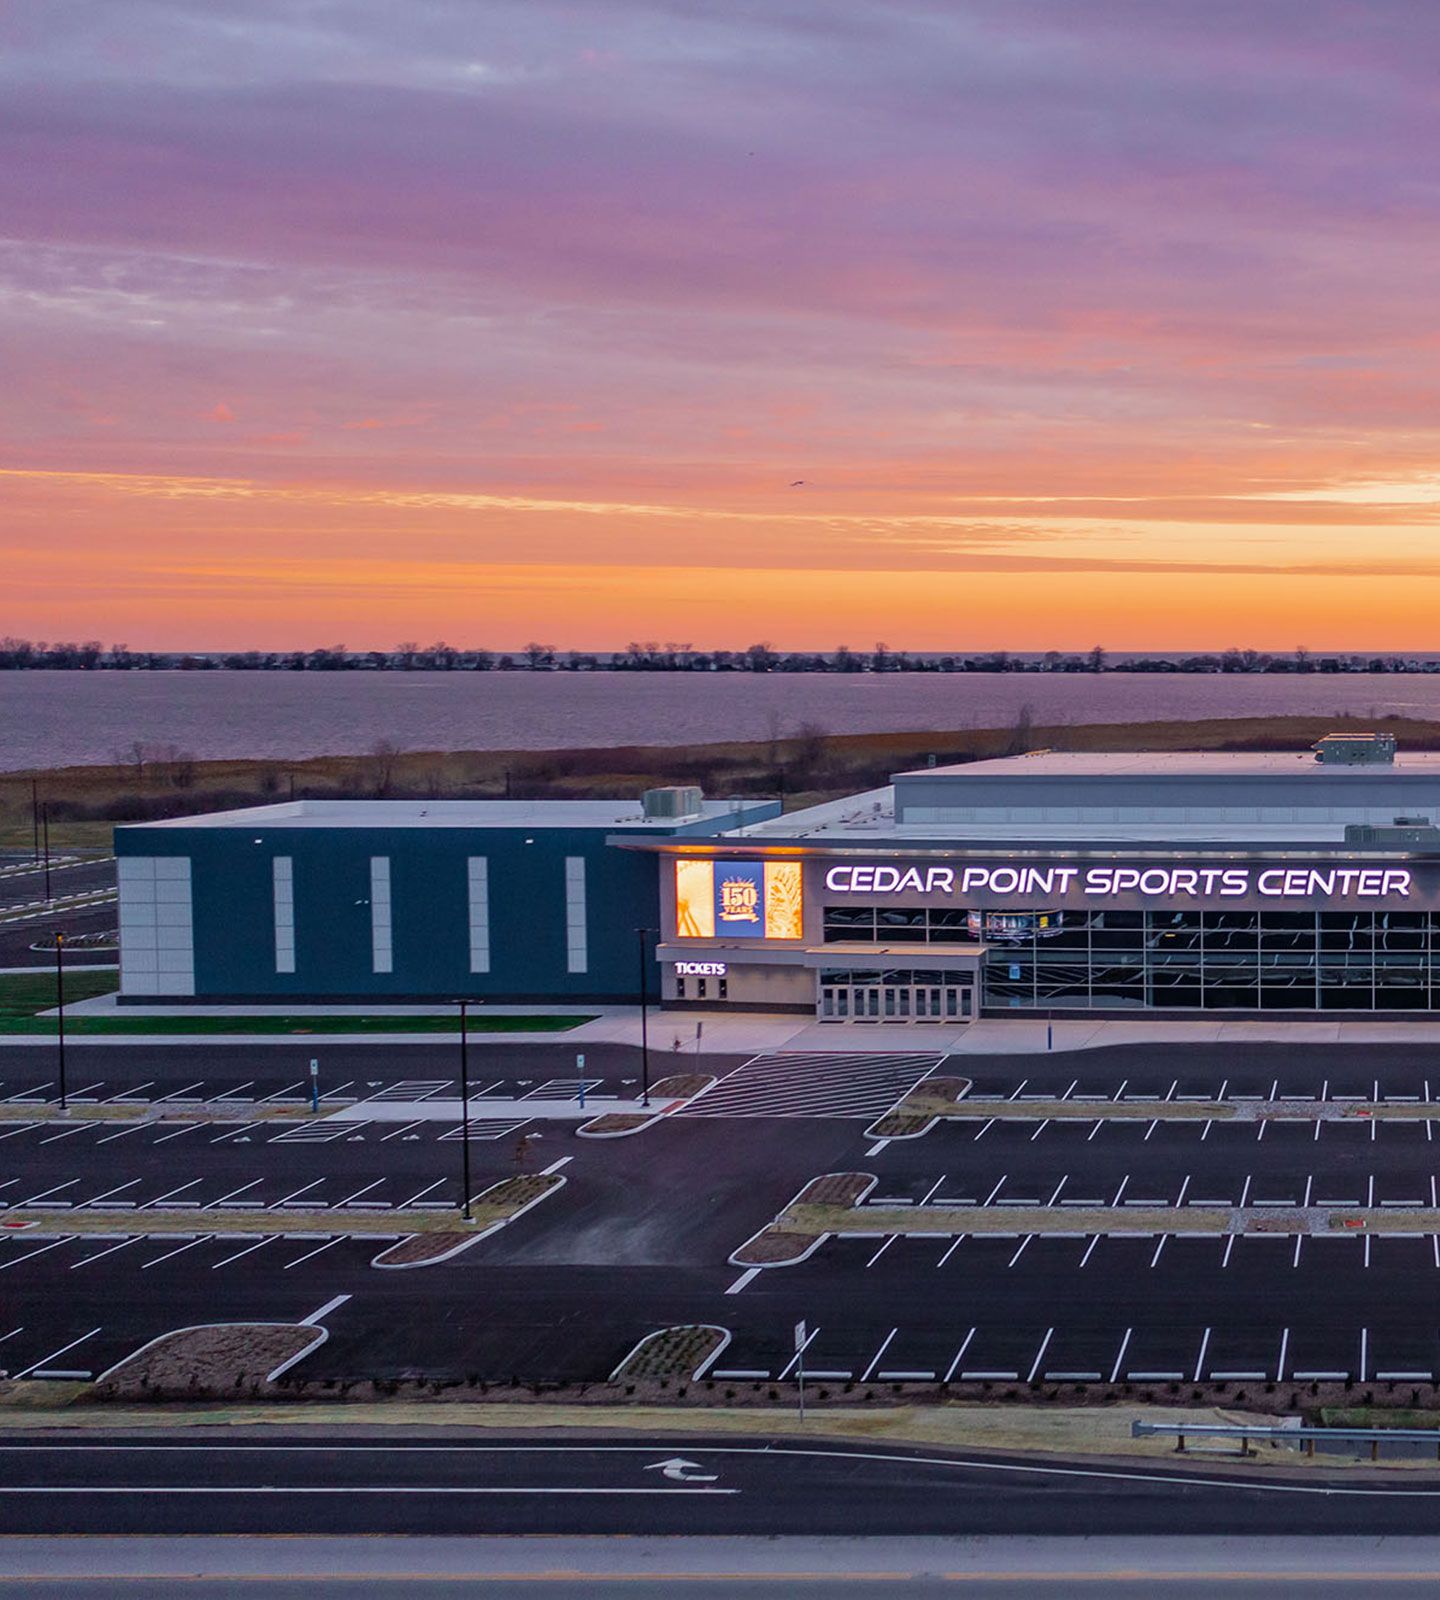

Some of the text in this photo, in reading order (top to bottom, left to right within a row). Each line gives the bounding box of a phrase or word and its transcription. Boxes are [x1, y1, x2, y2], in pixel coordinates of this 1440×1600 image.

[826, 866, 1410, 895] CEDAR POINT SPORTS CENTER
[722, 887, 757, 906] 150
[675, 961, 726, 976] TICKETS
